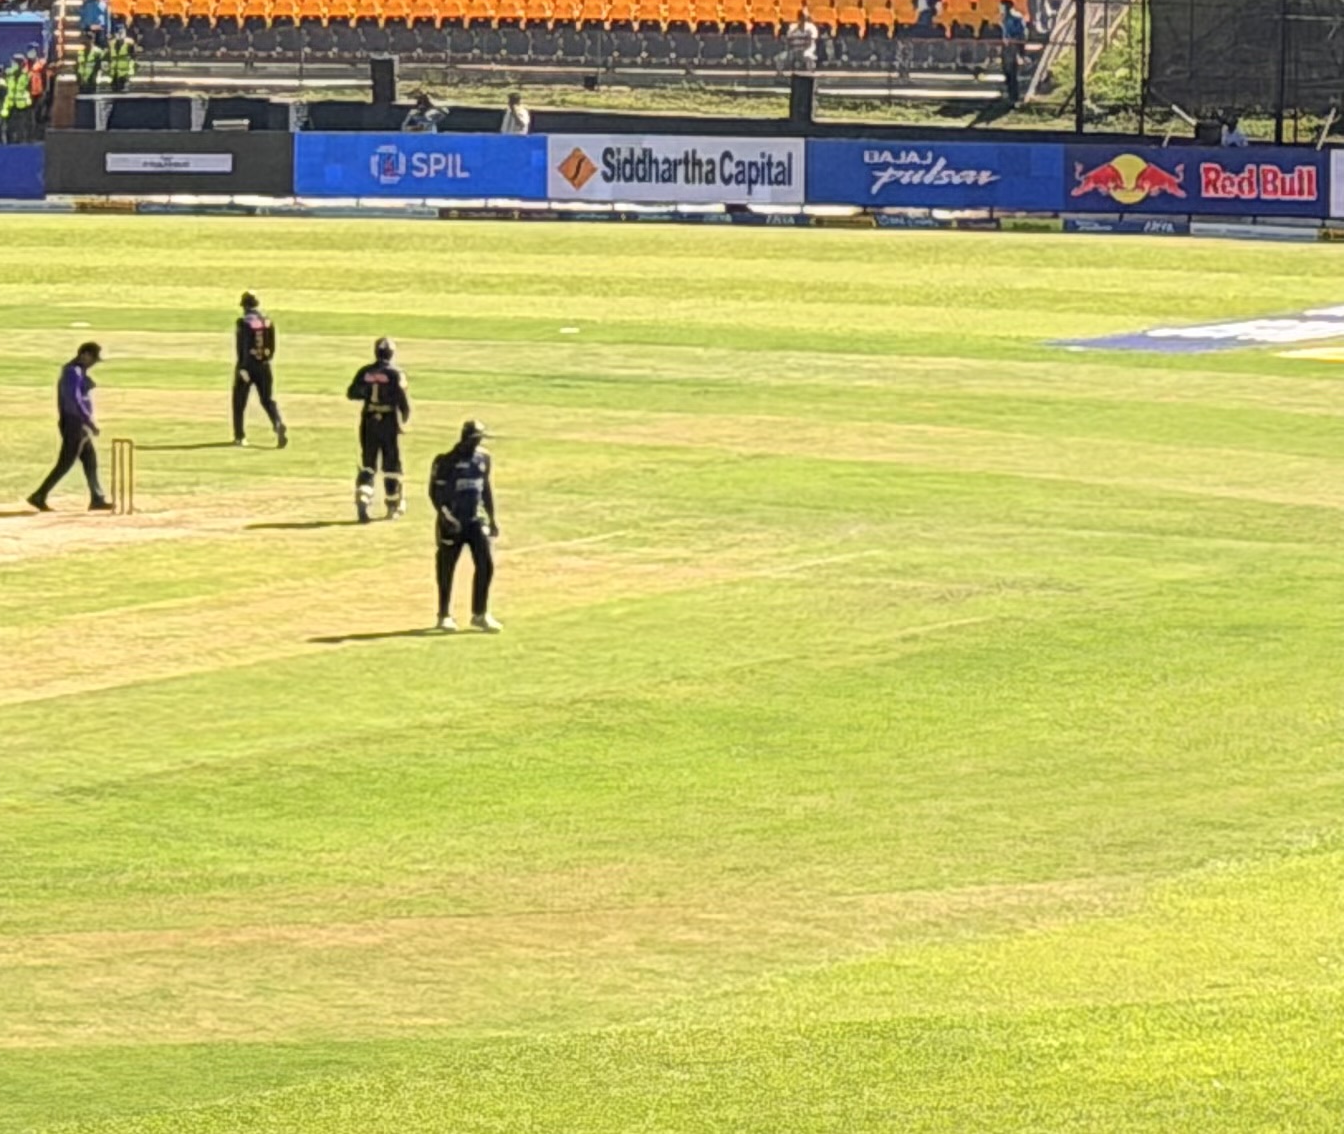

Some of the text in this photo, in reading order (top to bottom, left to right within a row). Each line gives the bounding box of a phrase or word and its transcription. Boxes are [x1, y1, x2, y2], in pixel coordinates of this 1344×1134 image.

[411, 152, 470, 179] SPIL
[601, 146, 792, 196] Siddhartha Capital
[863, 150, 933, 165] BAJAJ
[1200, 162, 1317, 200] Red Bull
